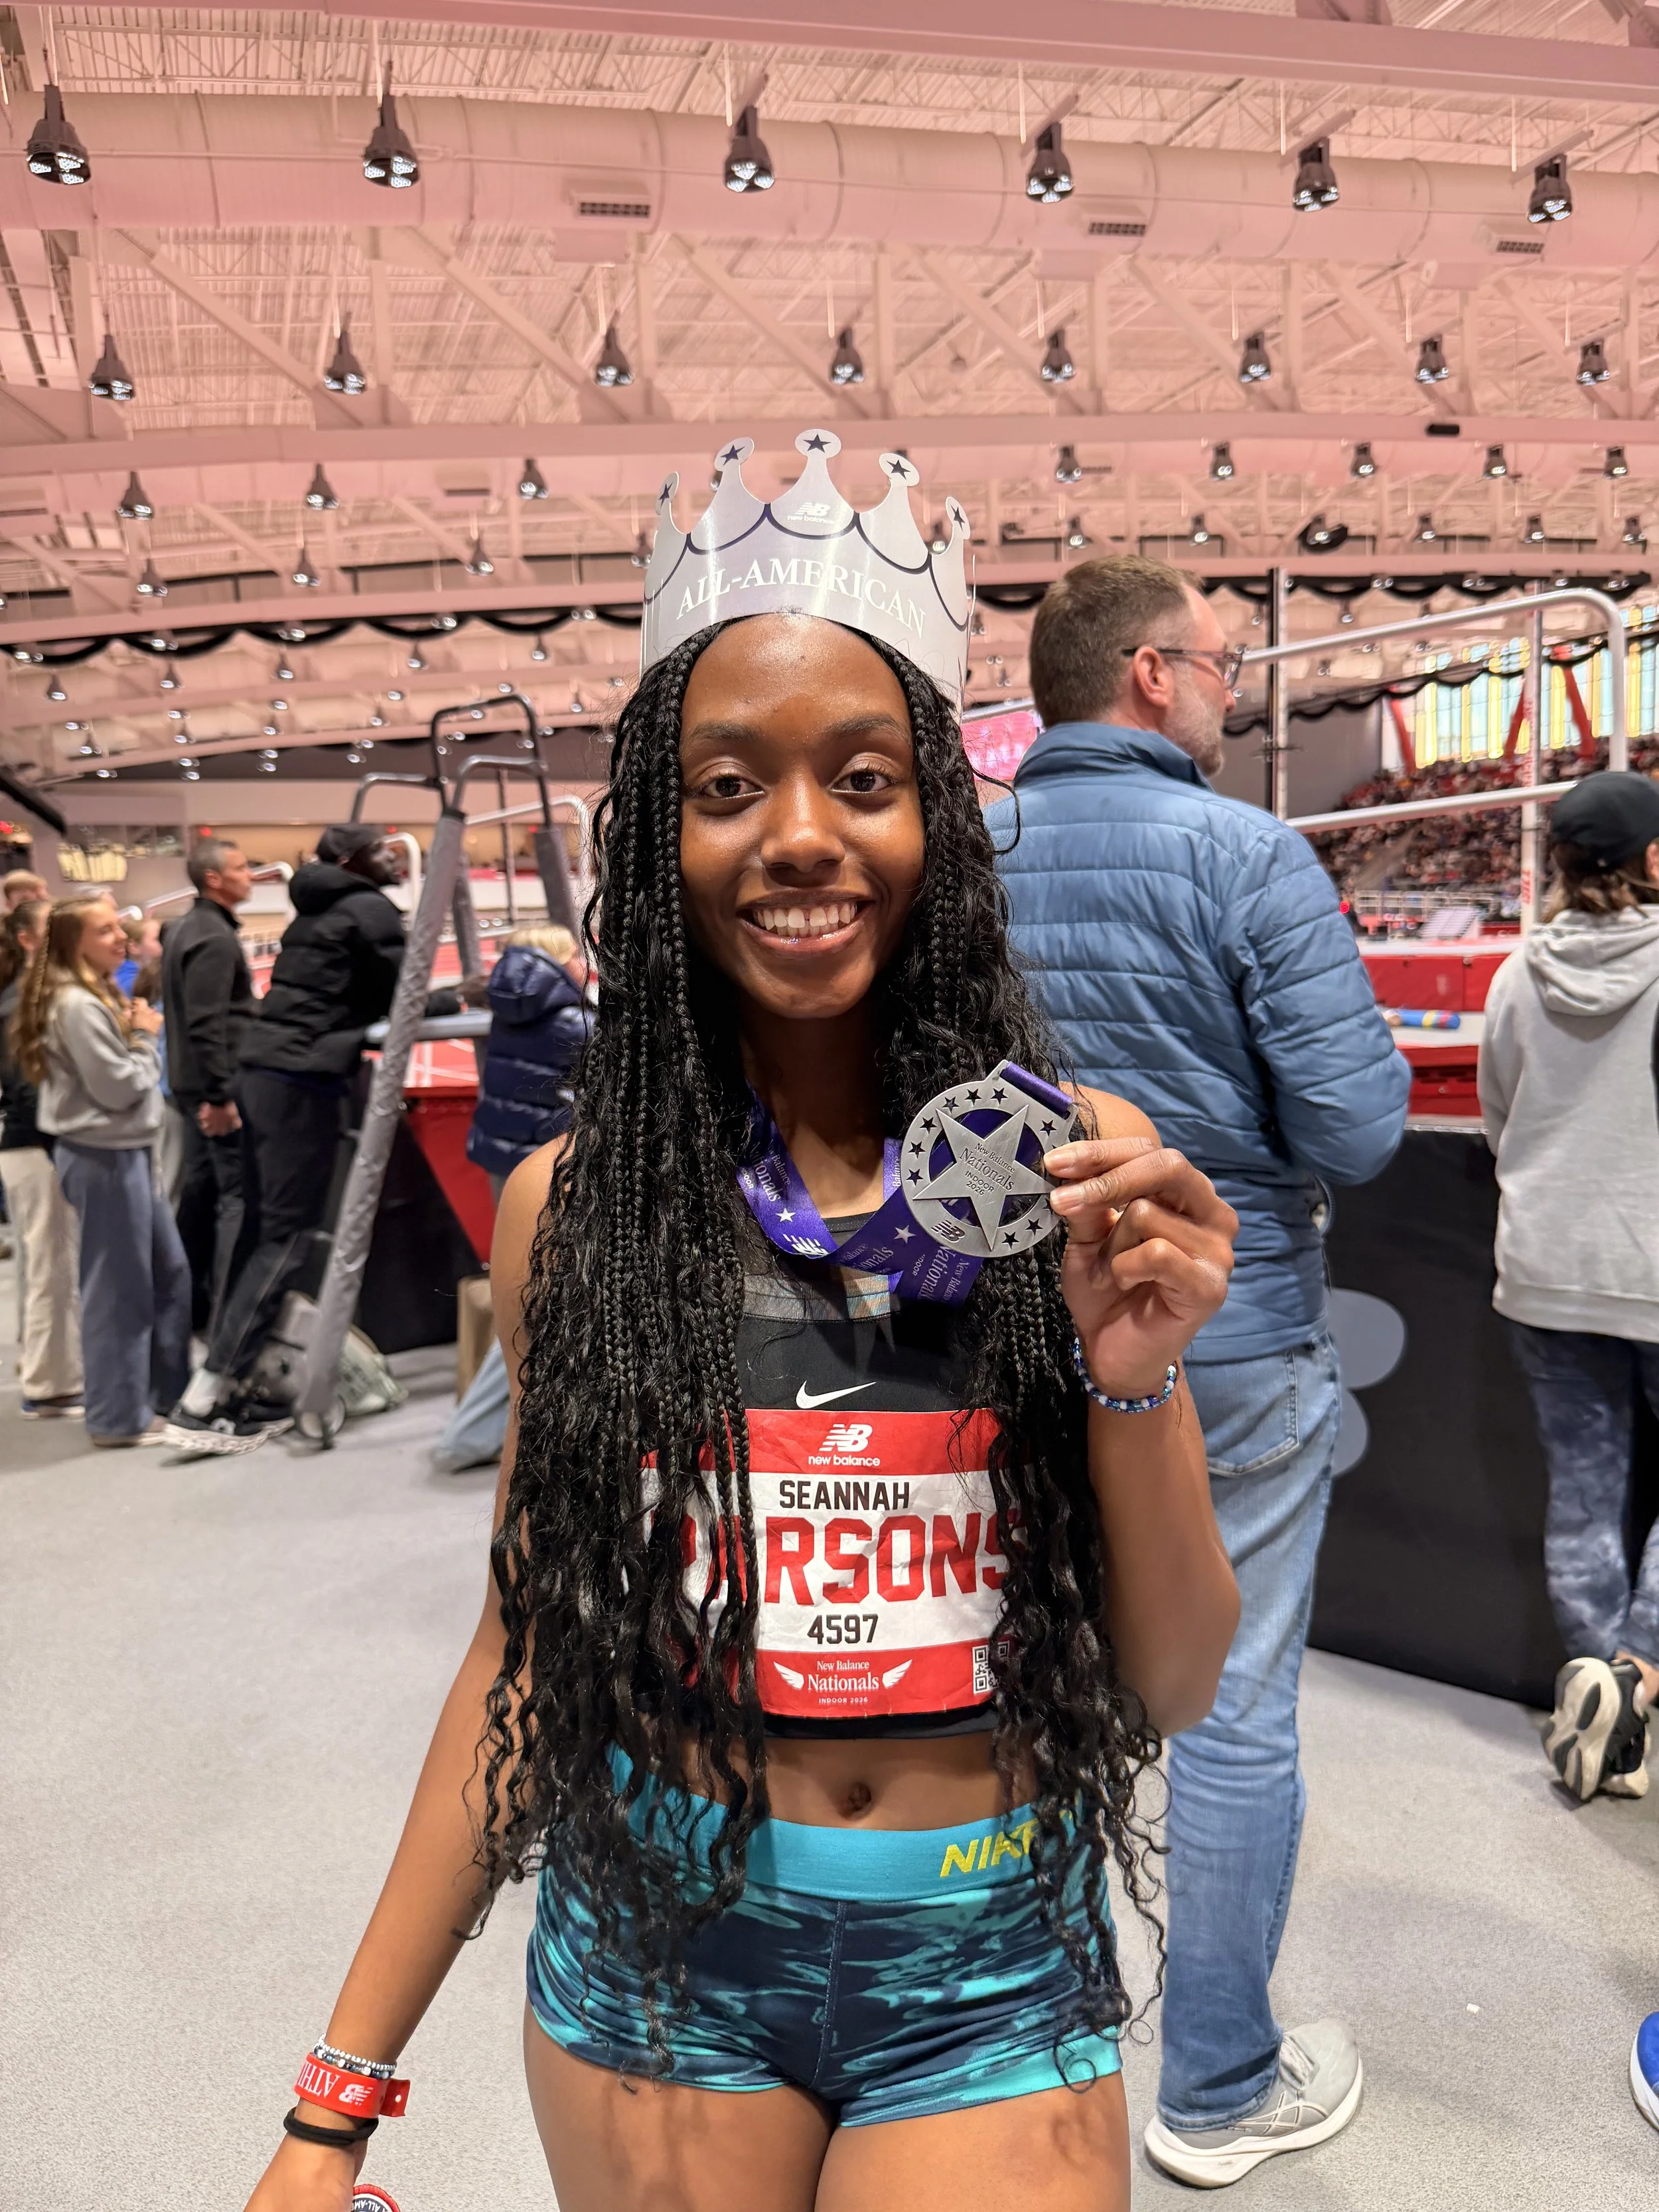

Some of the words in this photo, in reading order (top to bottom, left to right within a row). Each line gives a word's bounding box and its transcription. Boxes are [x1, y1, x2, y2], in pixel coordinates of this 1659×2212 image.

[676, 558, 926, 638] ALL-AMERICAN
[772, 1153, 791, 1185] Balance
[960, 1147, 1014, 1191] Nationals
[974, 1143, 990, 1156] New
[989, 1151, 1015, 1173] Balance
[965, 1171, 994, 1192] INDOOR
[966, 1181, 985, 1195] 2026
[819, 1424, 873, 1452] NB
[808, 1455, 831, 1465] new
[833, 1454, 881, 1467] balance
[780, 1480, 910, 1511] SEANNAH
[807, 1613, 879, 1645] 4597
[817, 1660, 834, 1670] New
[836, 1659, 869, 1670] Balance
[808, 1671, 879, 1692] Nationals
